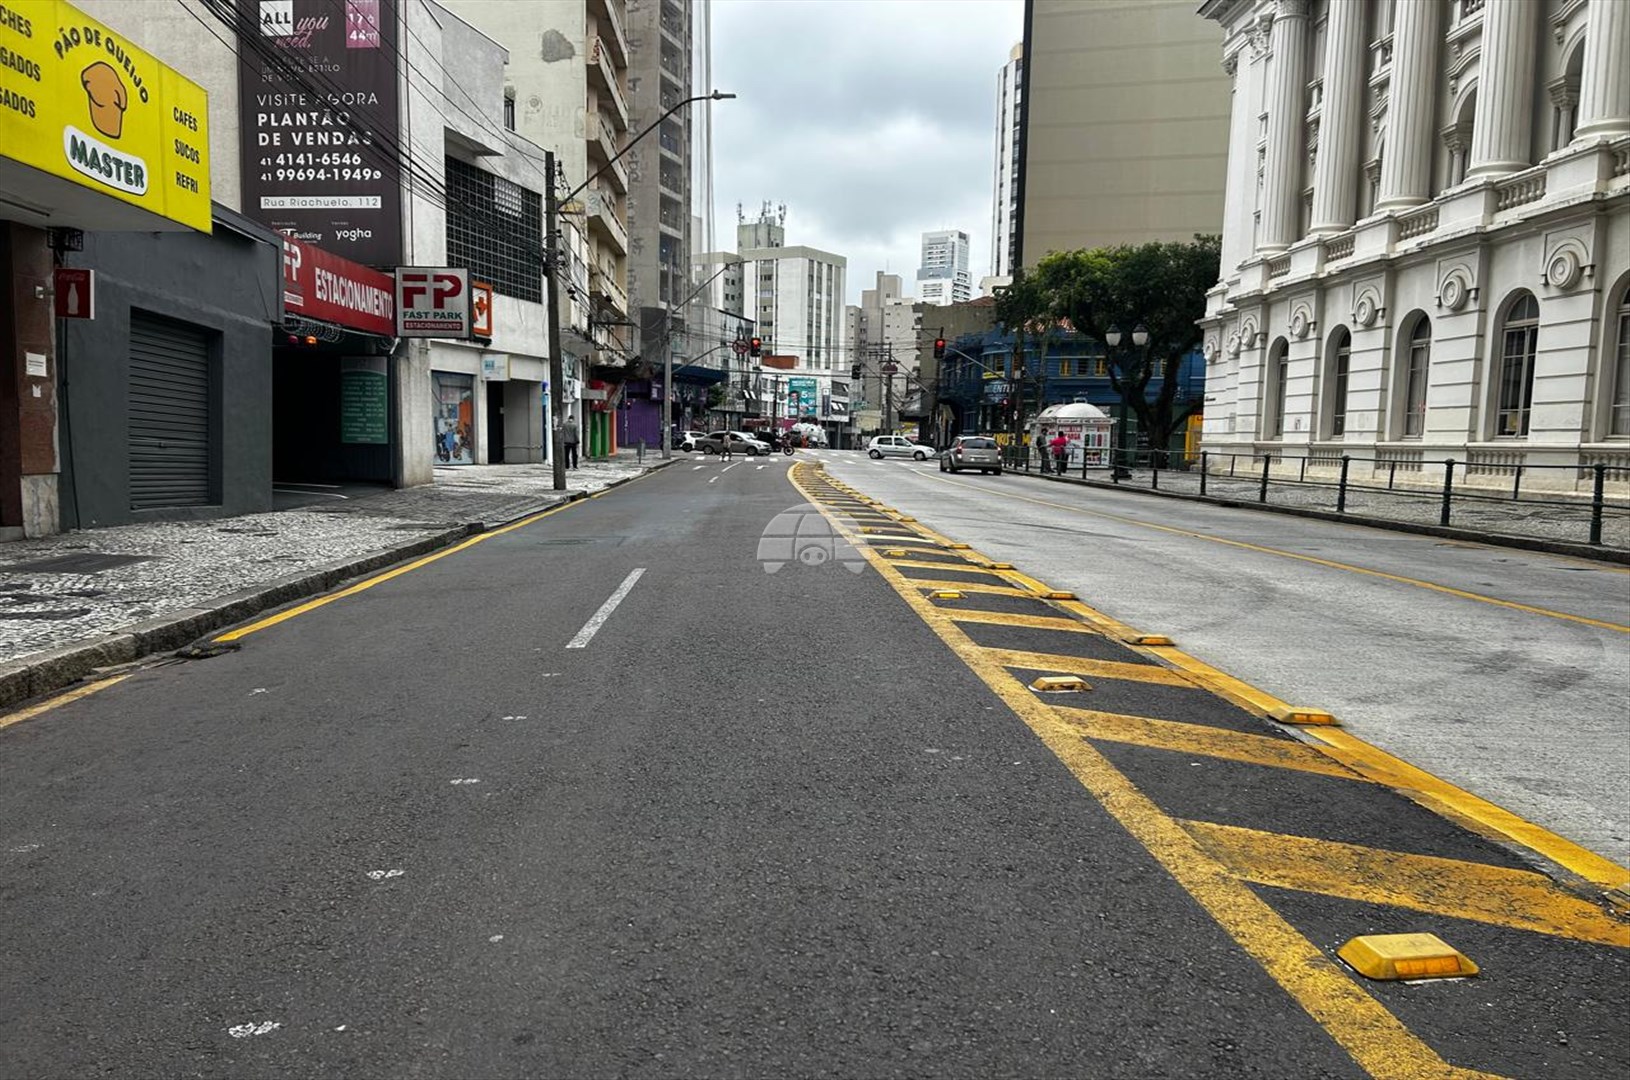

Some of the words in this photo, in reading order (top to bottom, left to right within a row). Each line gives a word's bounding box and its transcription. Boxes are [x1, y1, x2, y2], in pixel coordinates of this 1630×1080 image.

[263, 12, 291, 25] ALL
[54, 28, 81, 60] PÃO
[83, 26, 101, 47] DE
[105, 37, 149, 103] QUEIJO
[257, 93, 307, 106] VISITE
[173, 106, 198, 132] CAFÉS
[257, 108, 351, 127] PLANTÃO
[258, 133, 281, 146] DE
[291, 131, 373, 146] VENDAS
[174, 138, 200, 165] SUCOS
[260, 157, 272, 166] 41
[275, 153, 362, 166] 4141-6546
[70, 134, 145, 189] MASTER
[176, 171, 199, 194] REFRI
[260, 173, 273, 181] 41
[276, 168, 372, 181] 99694-1949
[263, 198, 286, 207] Rua
[358, 198, 379, 207] 112
[335, 228, 372, 242] yogha
[314, 266, 394, 320] ESTACIONAMENTO
[402, 274, 463, 309] FP
[403, 311, 430, 319] FAST
[433, 311, 463, 320] PARK
